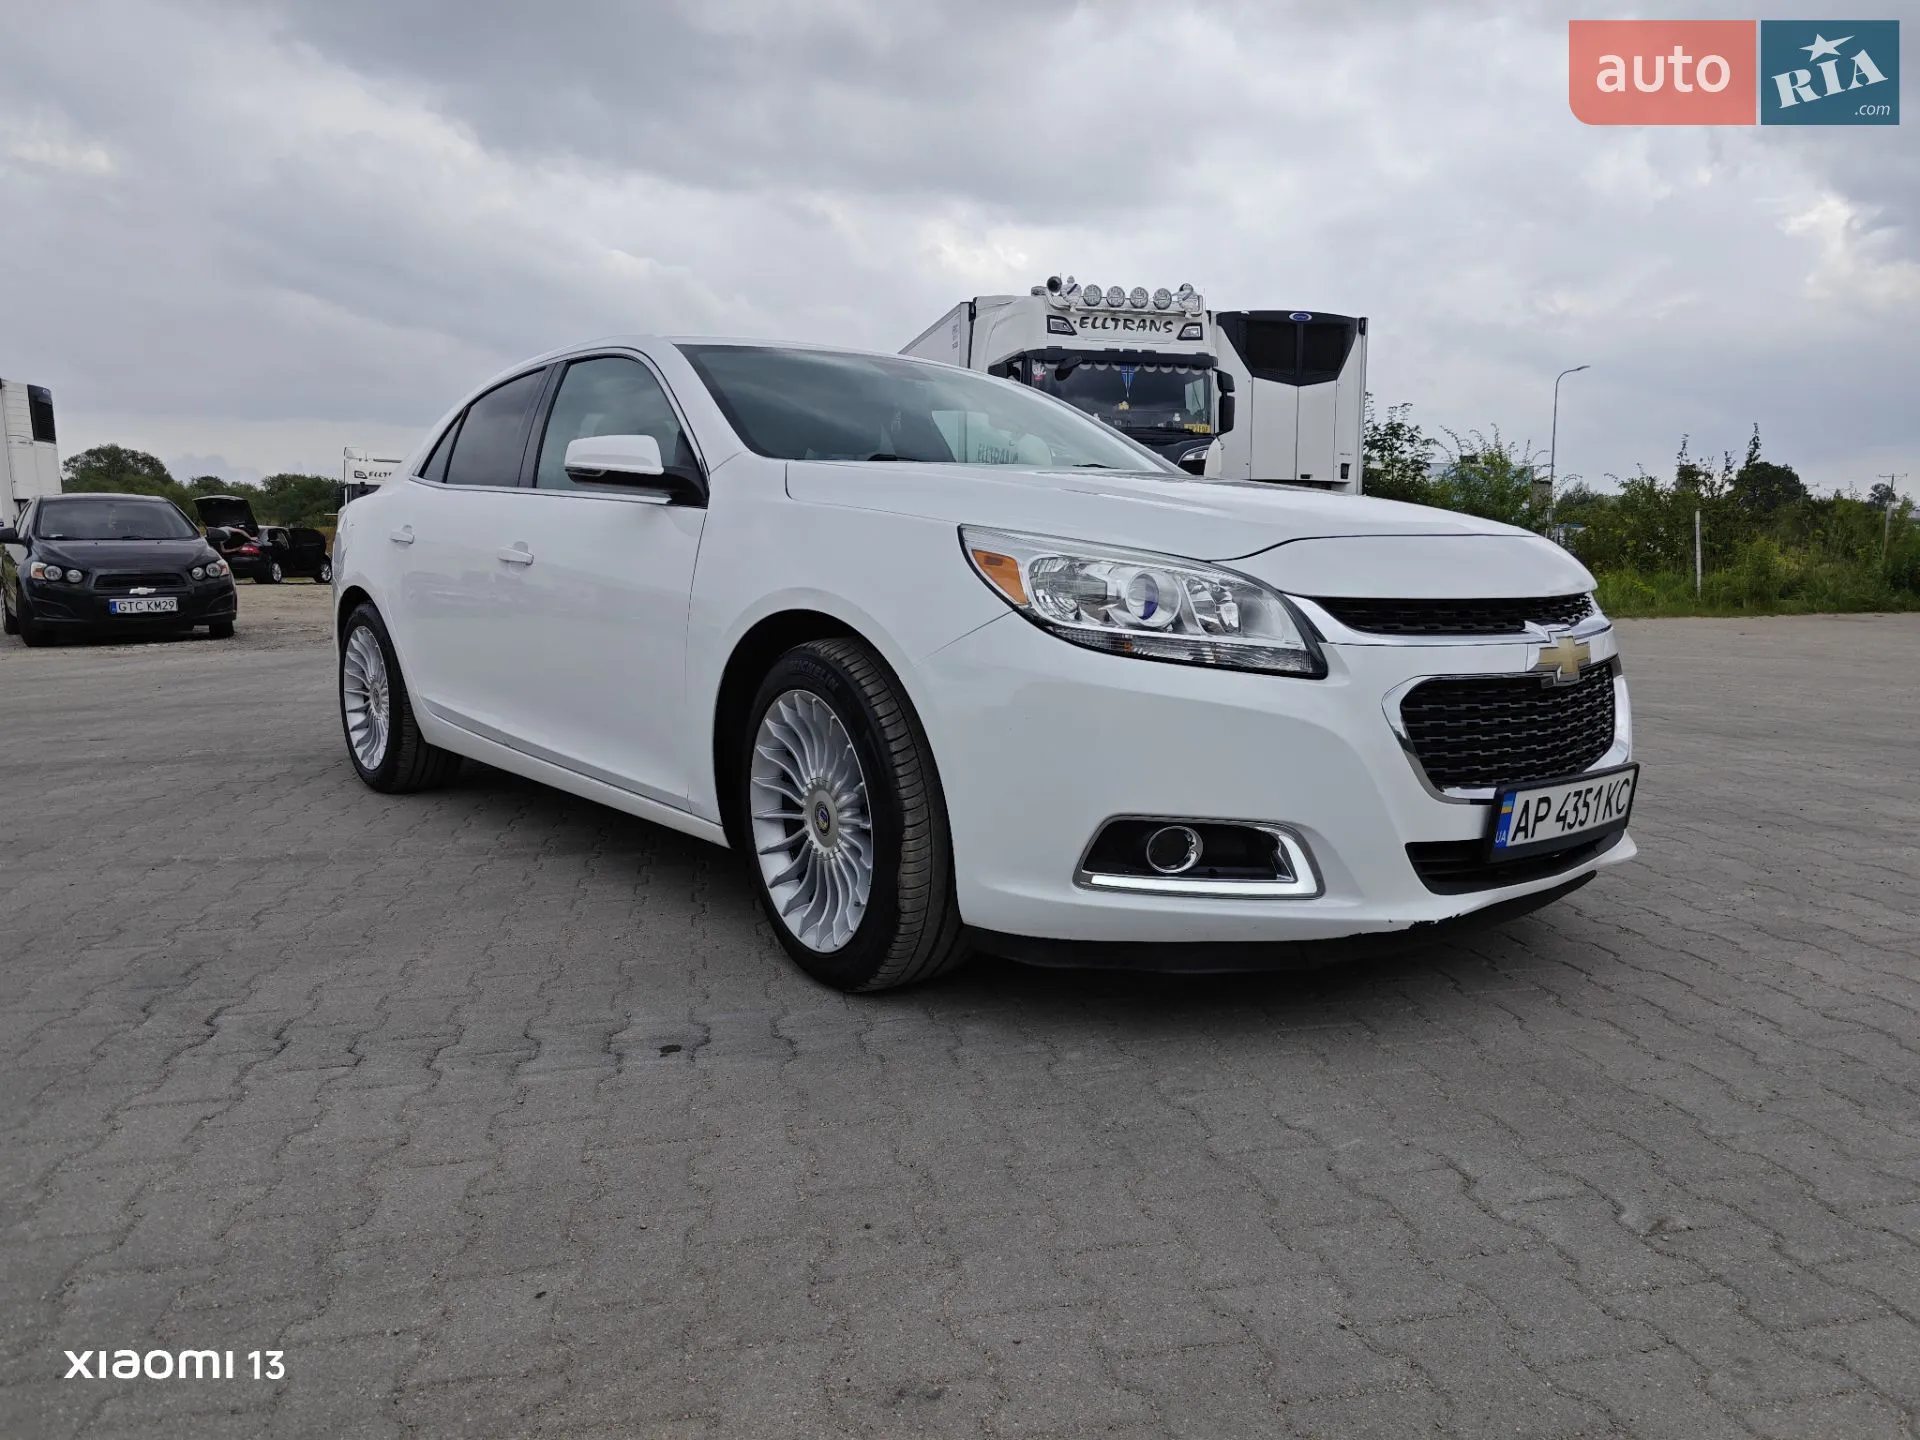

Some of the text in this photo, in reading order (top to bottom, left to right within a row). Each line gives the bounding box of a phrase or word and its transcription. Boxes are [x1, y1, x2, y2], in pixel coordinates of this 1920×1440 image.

[1079, 317, 1173, 333] ELLTRANS
[119, 600, 174, 612] GTC KM29
[1511, 778, 1630, 841] AP 4351 KC
[1495, 829, 1507, 843] UA
